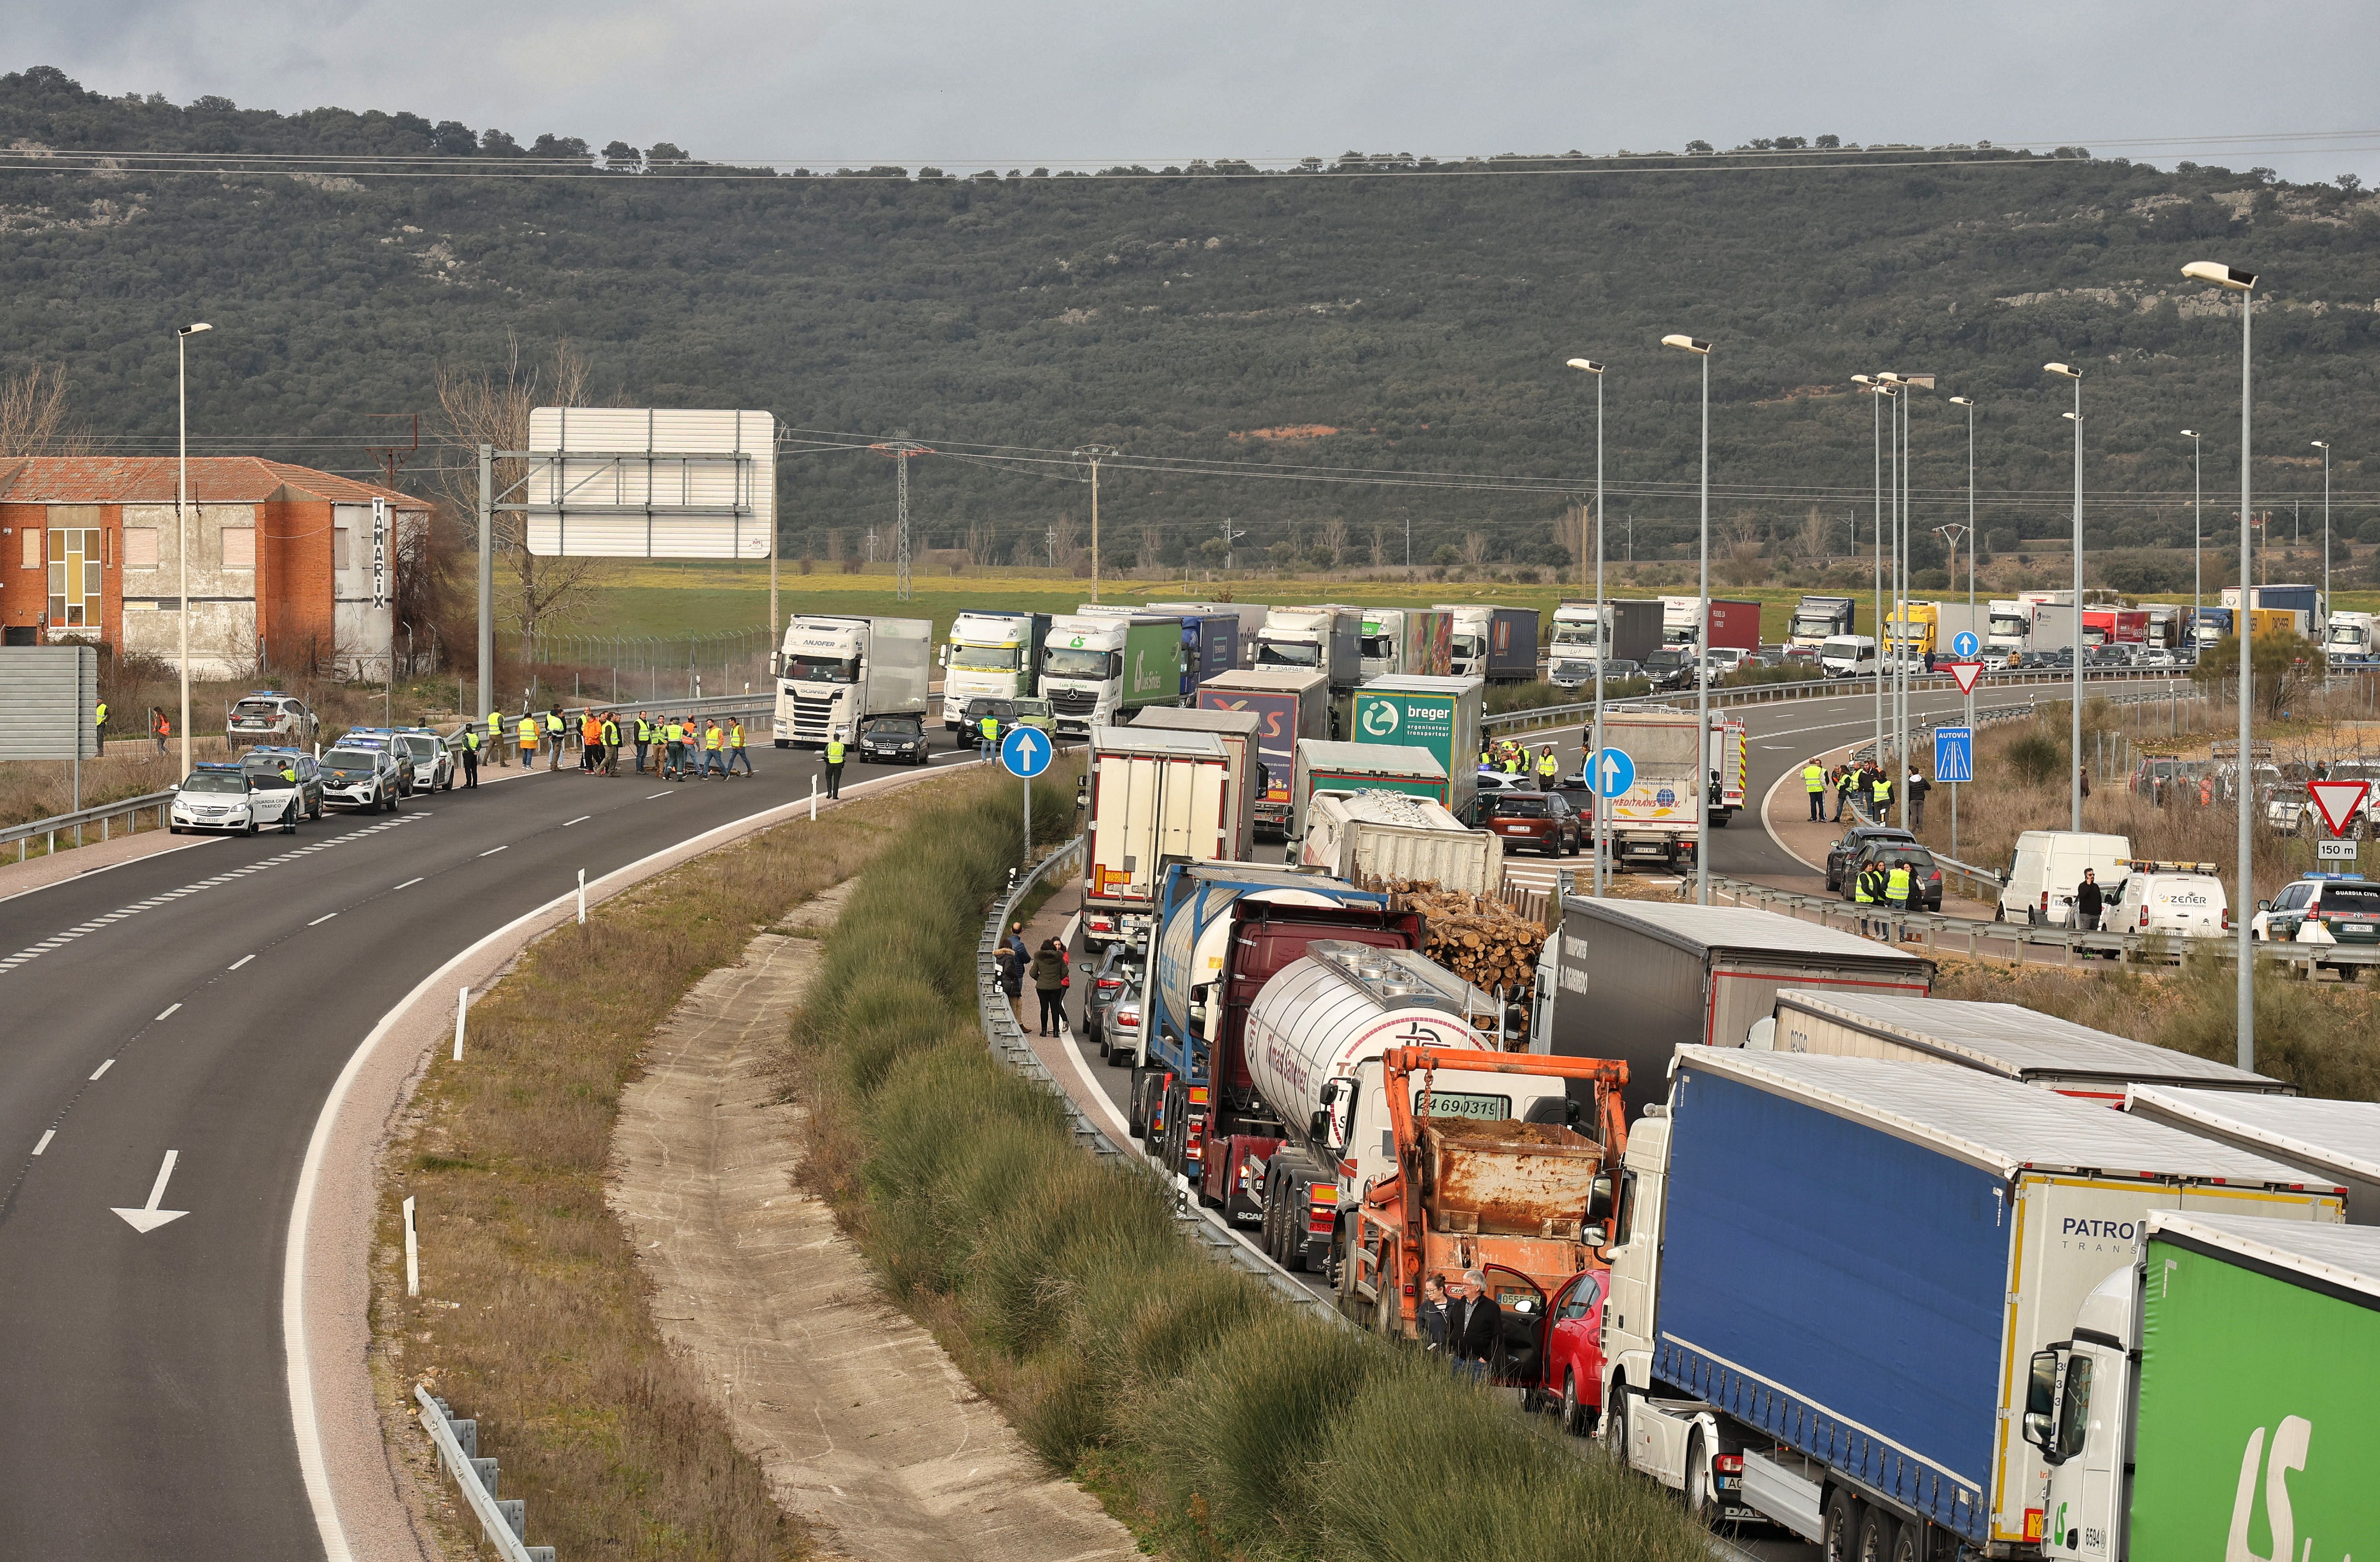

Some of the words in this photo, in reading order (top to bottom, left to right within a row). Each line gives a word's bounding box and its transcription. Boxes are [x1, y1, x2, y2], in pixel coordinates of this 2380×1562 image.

[1408, 705, 1450, 721] breger
[2322, 845, 2340, 854] 150
[1565, 935, 1587, 960] TRANSPORTES
[1564, 966, 1587, 995] FIGUEIREDO
[2063, 1218, 2134, 1239] PATRO
[2086, 1527, 2100, 1548] 6594
